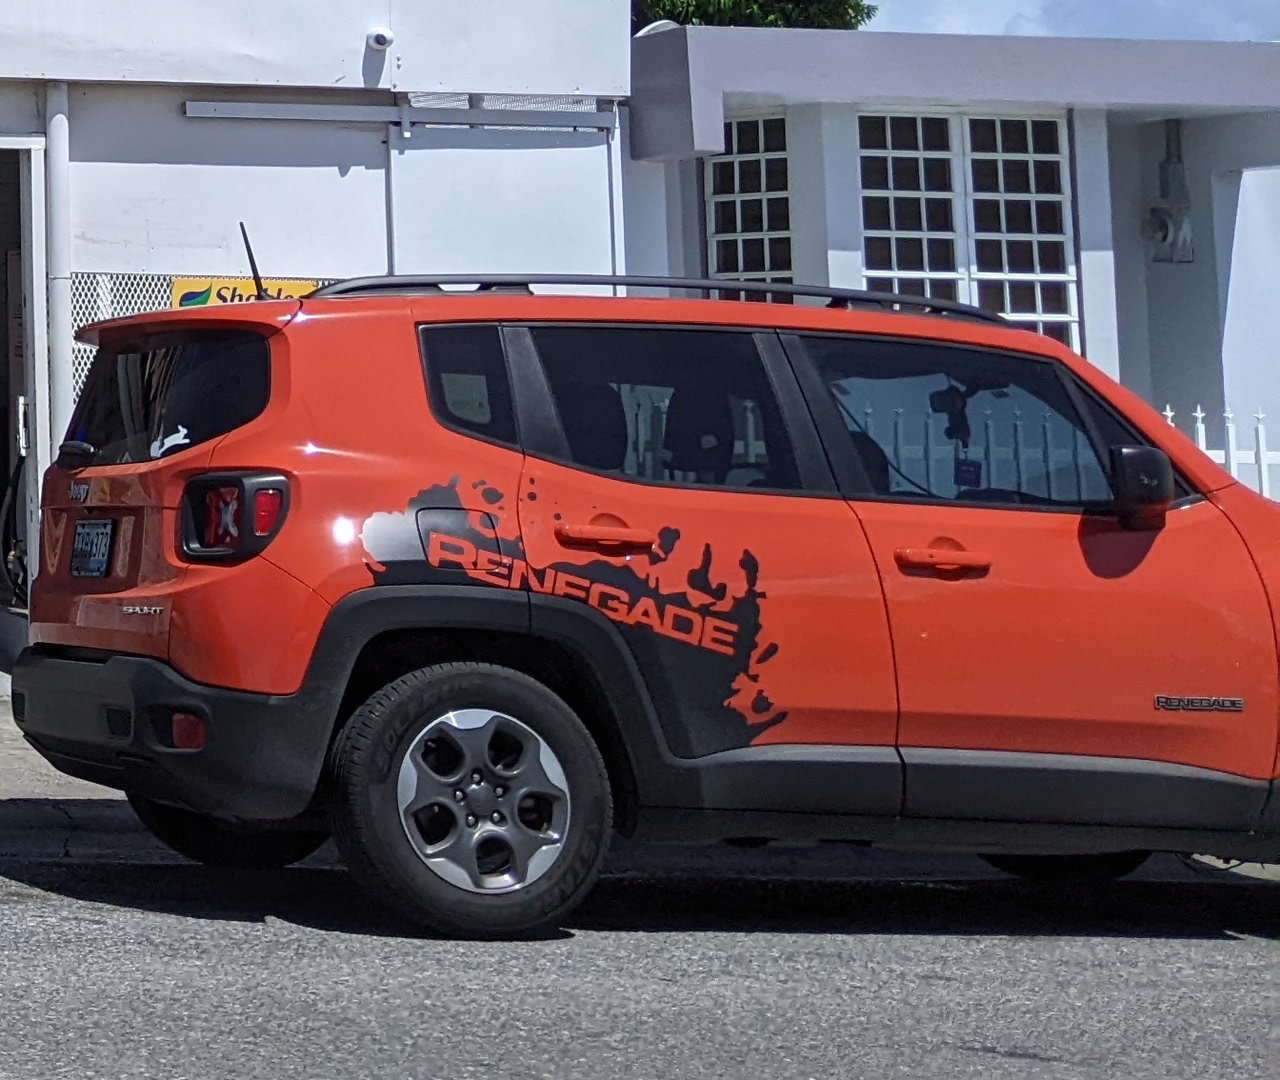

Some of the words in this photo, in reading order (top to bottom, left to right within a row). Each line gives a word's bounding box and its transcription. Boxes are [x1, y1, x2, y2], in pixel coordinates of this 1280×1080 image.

[68, 481, 89, 502] Jeep
[428, 531, 739, 657] RENEGADE
[122, 606, 164, 615] SPORT
[1155, 695, 1244, 710] RENEGADE
